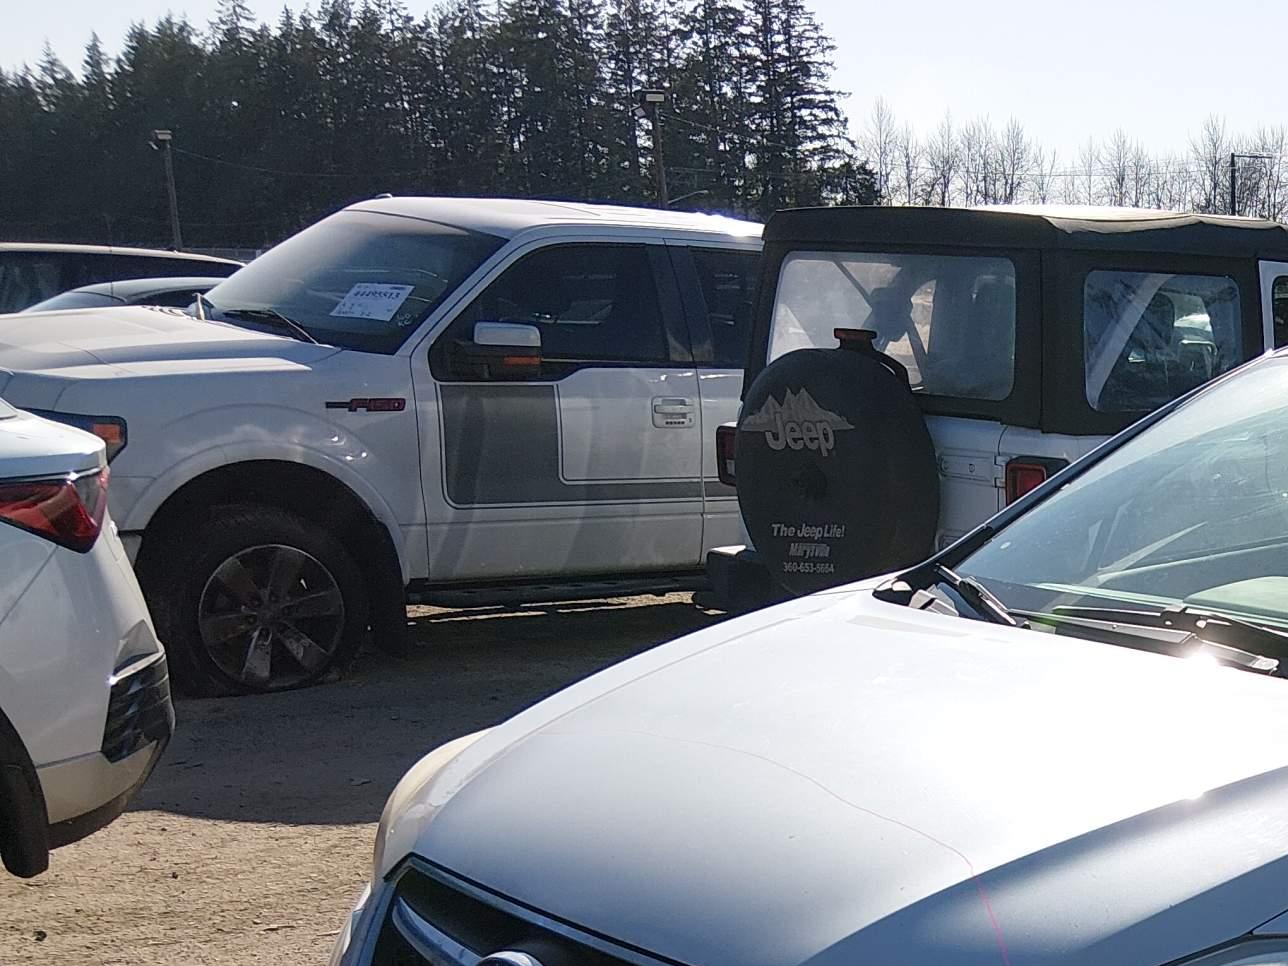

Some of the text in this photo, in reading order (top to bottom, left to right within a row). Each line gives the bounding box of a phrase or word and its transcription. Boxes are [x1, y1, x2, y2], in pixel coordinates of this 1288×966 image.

[764, 411, 834, 457] Jeep
[771, 523, 796, 537] The
[797, 523, 823, 540] Jeep
